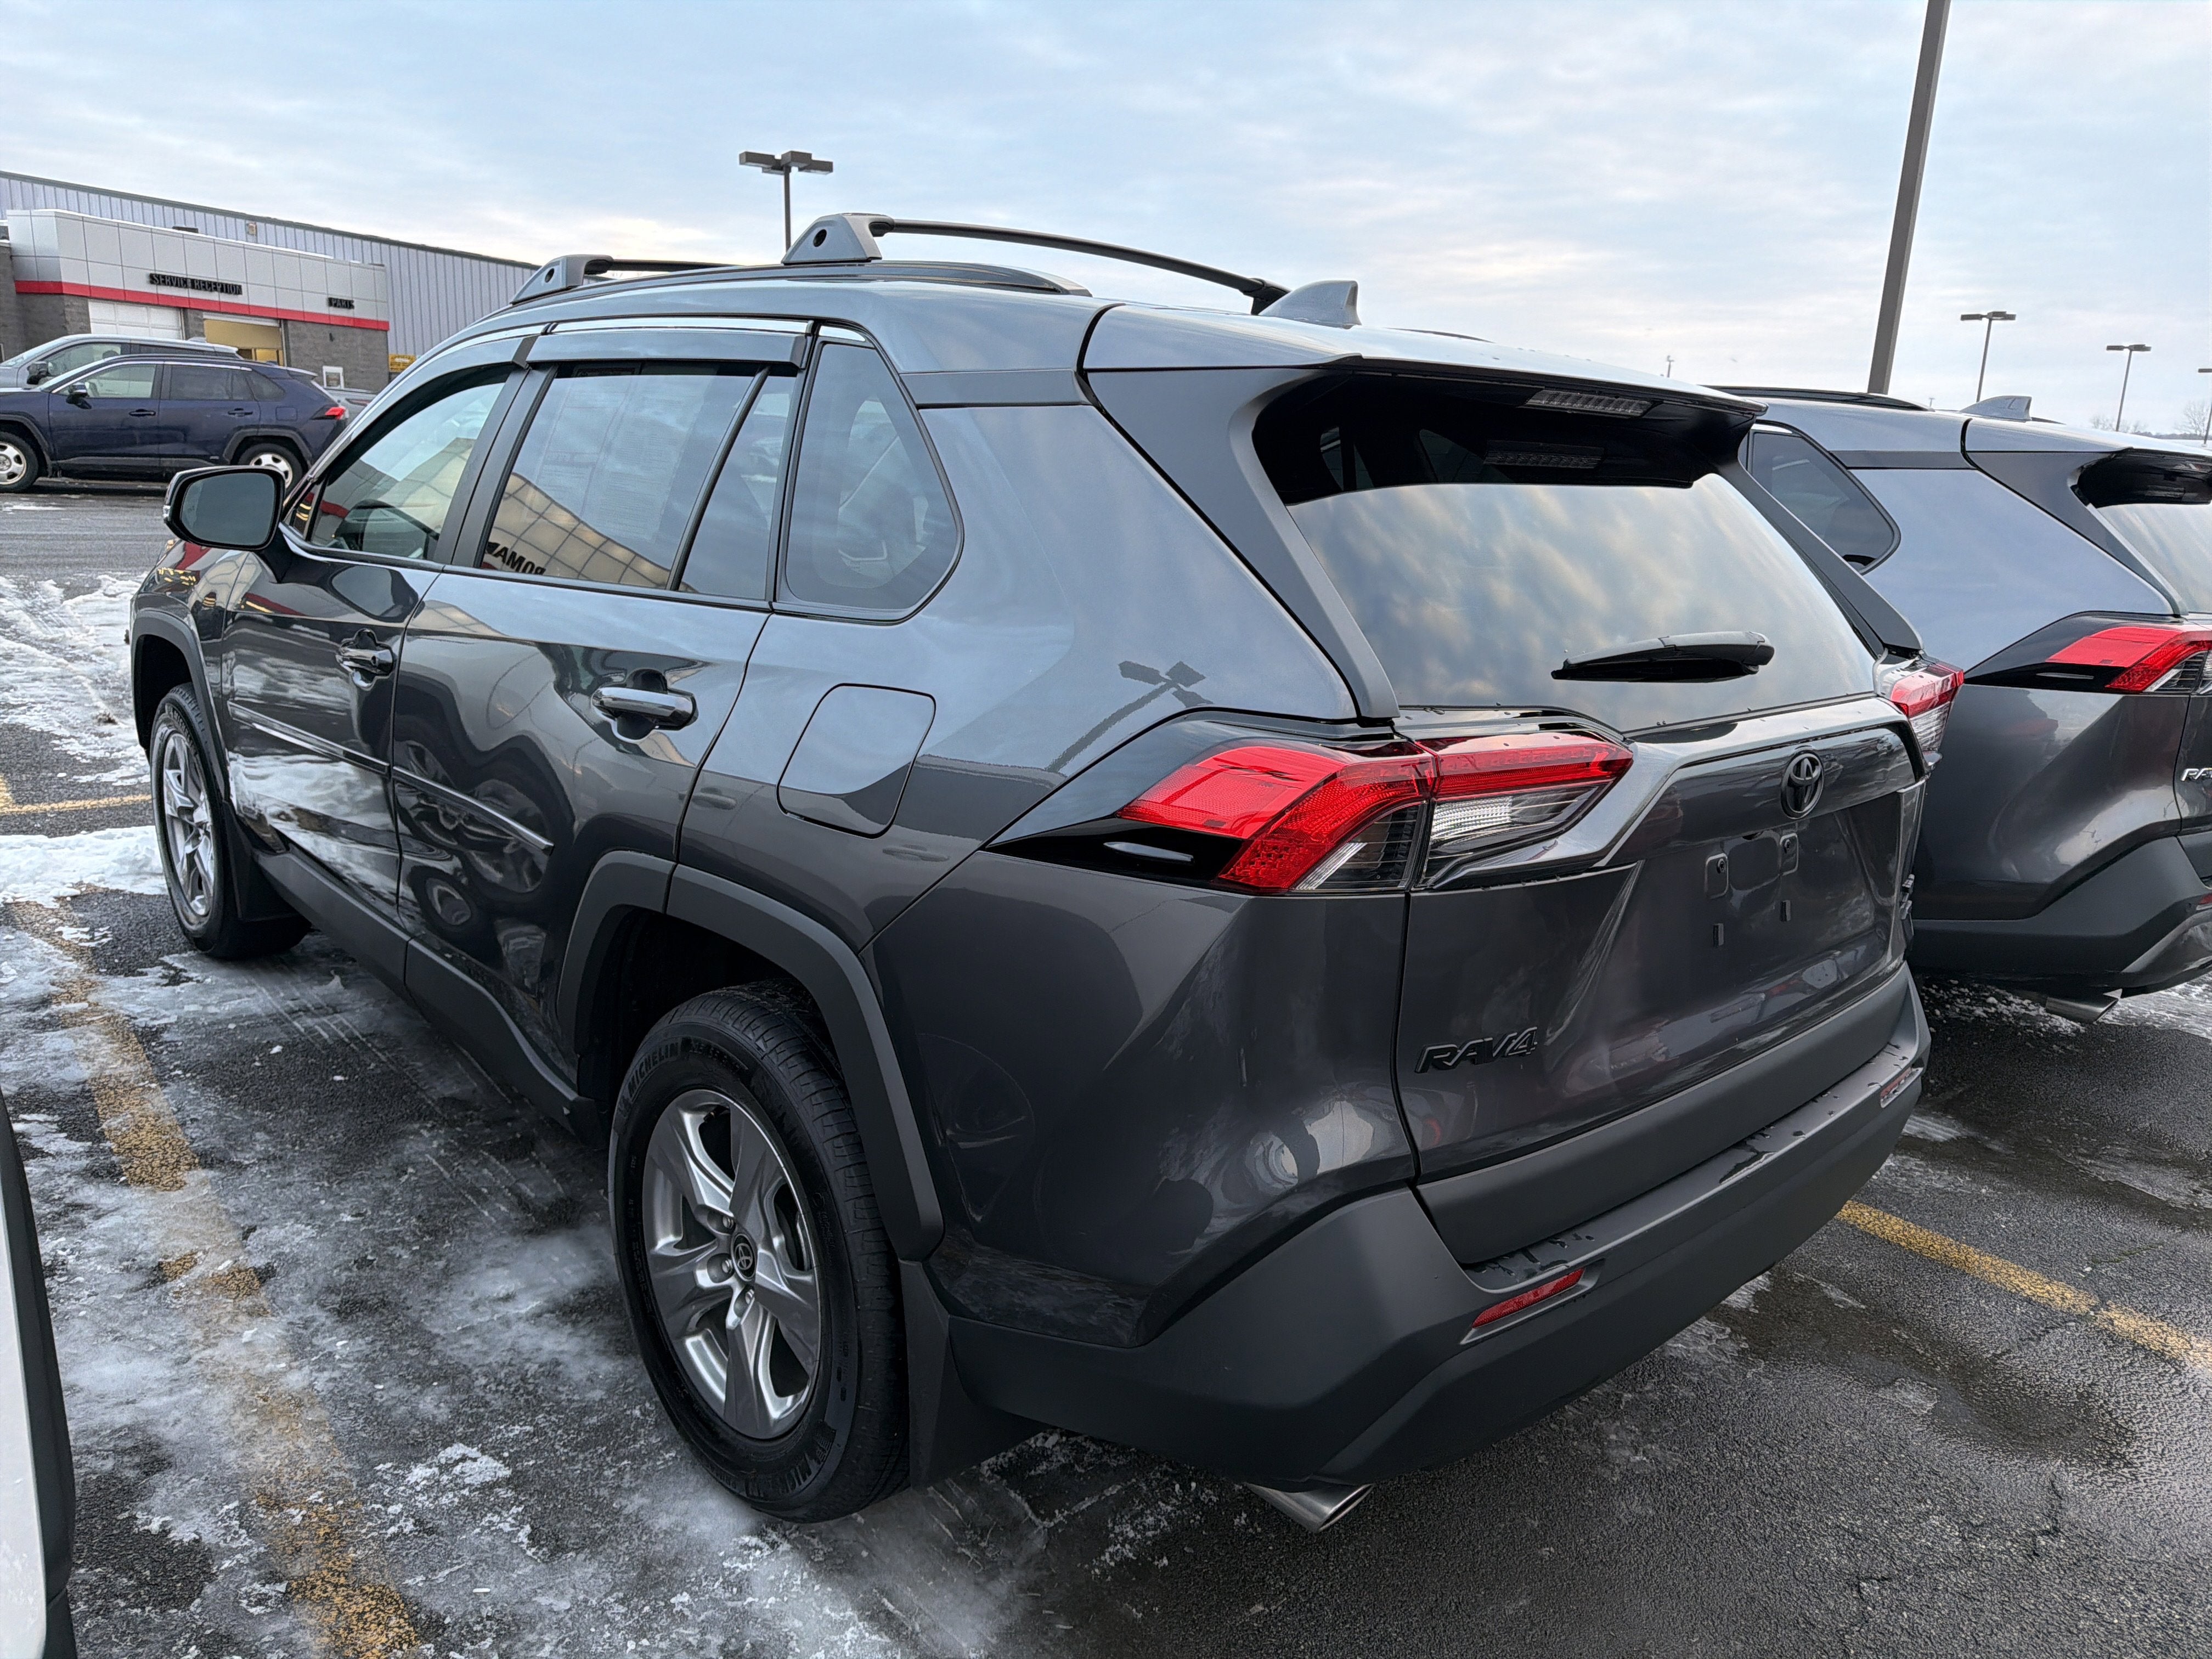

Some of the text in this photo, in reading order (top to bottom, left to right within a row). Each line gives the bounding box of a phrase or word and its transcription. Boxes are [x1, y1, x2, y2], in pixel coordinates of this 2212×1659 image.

[194, 279, 242, 295] RECEPTION
[2181, 768, 2212, 781] RA
[1414, 1026, 1538, 1074] RAV4
[627, 1041, 679, 1098] MICHELIN
